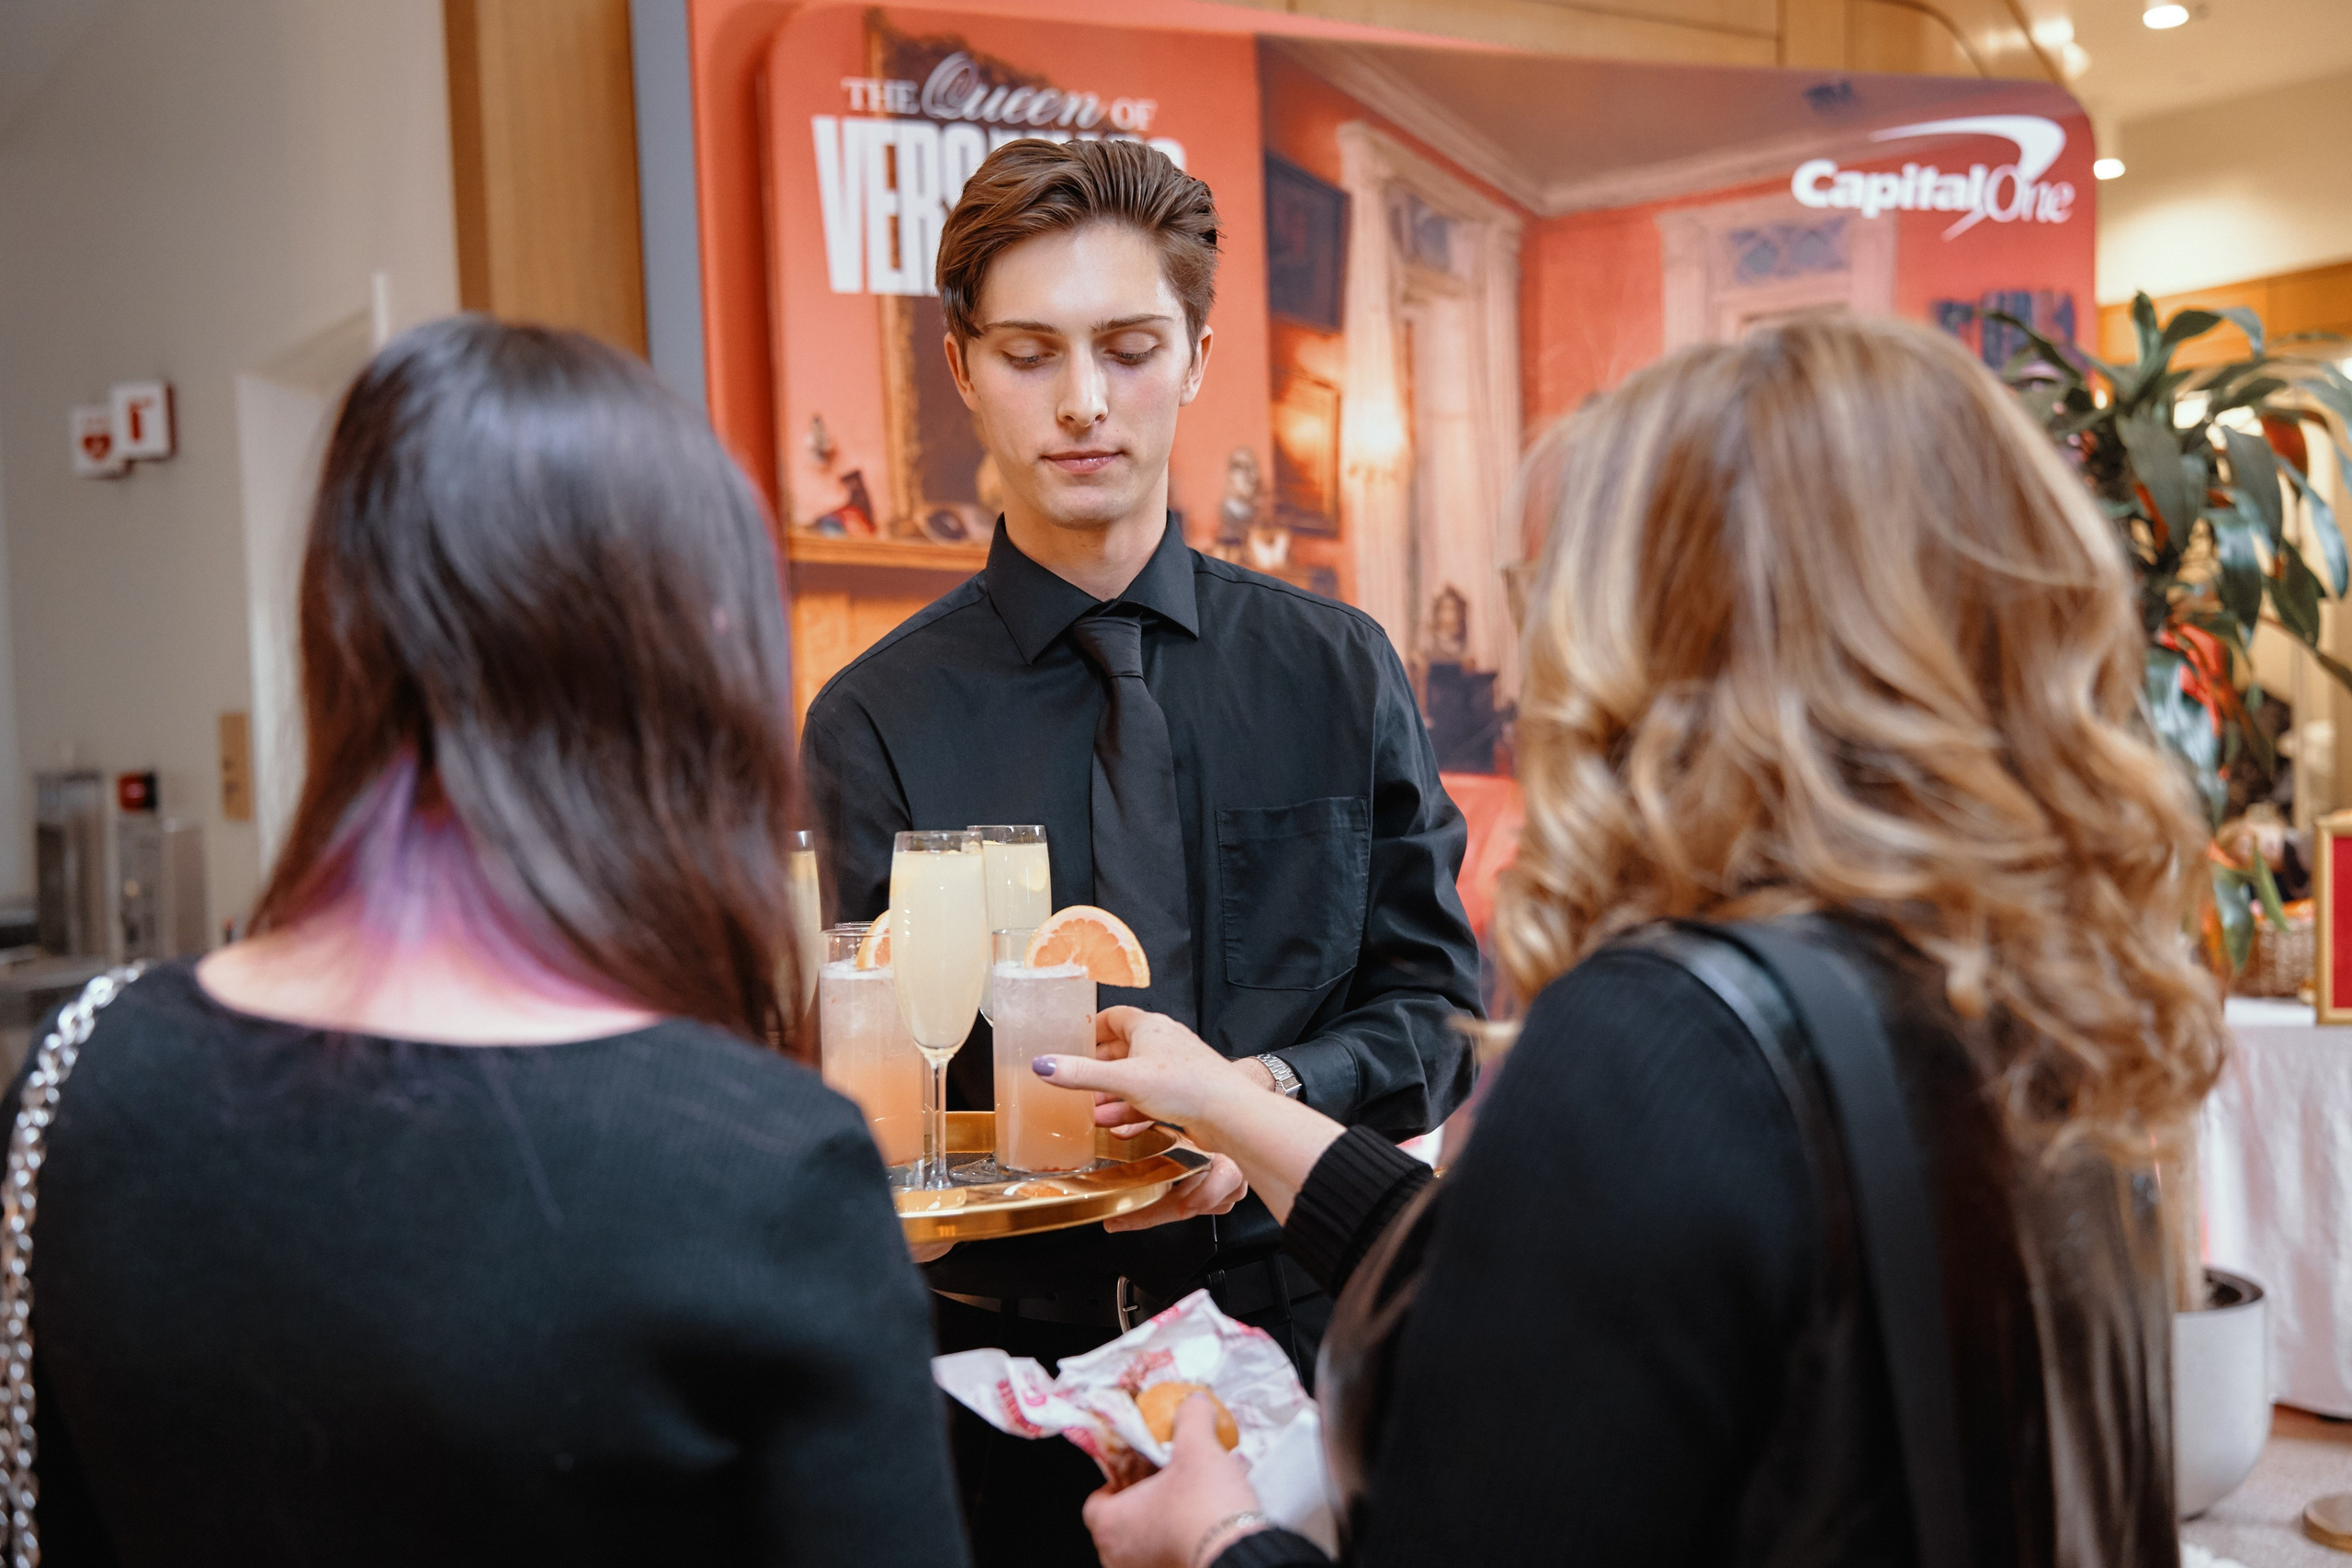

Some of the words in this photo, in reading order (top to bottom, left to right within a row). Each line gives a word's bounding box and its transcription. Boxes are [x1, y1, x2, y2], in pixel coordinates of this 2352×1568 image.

[840, 77, 919, 114] THE
[920, 51, 1101, 128] Queen
[1110, 97, 1158, 130] OF
